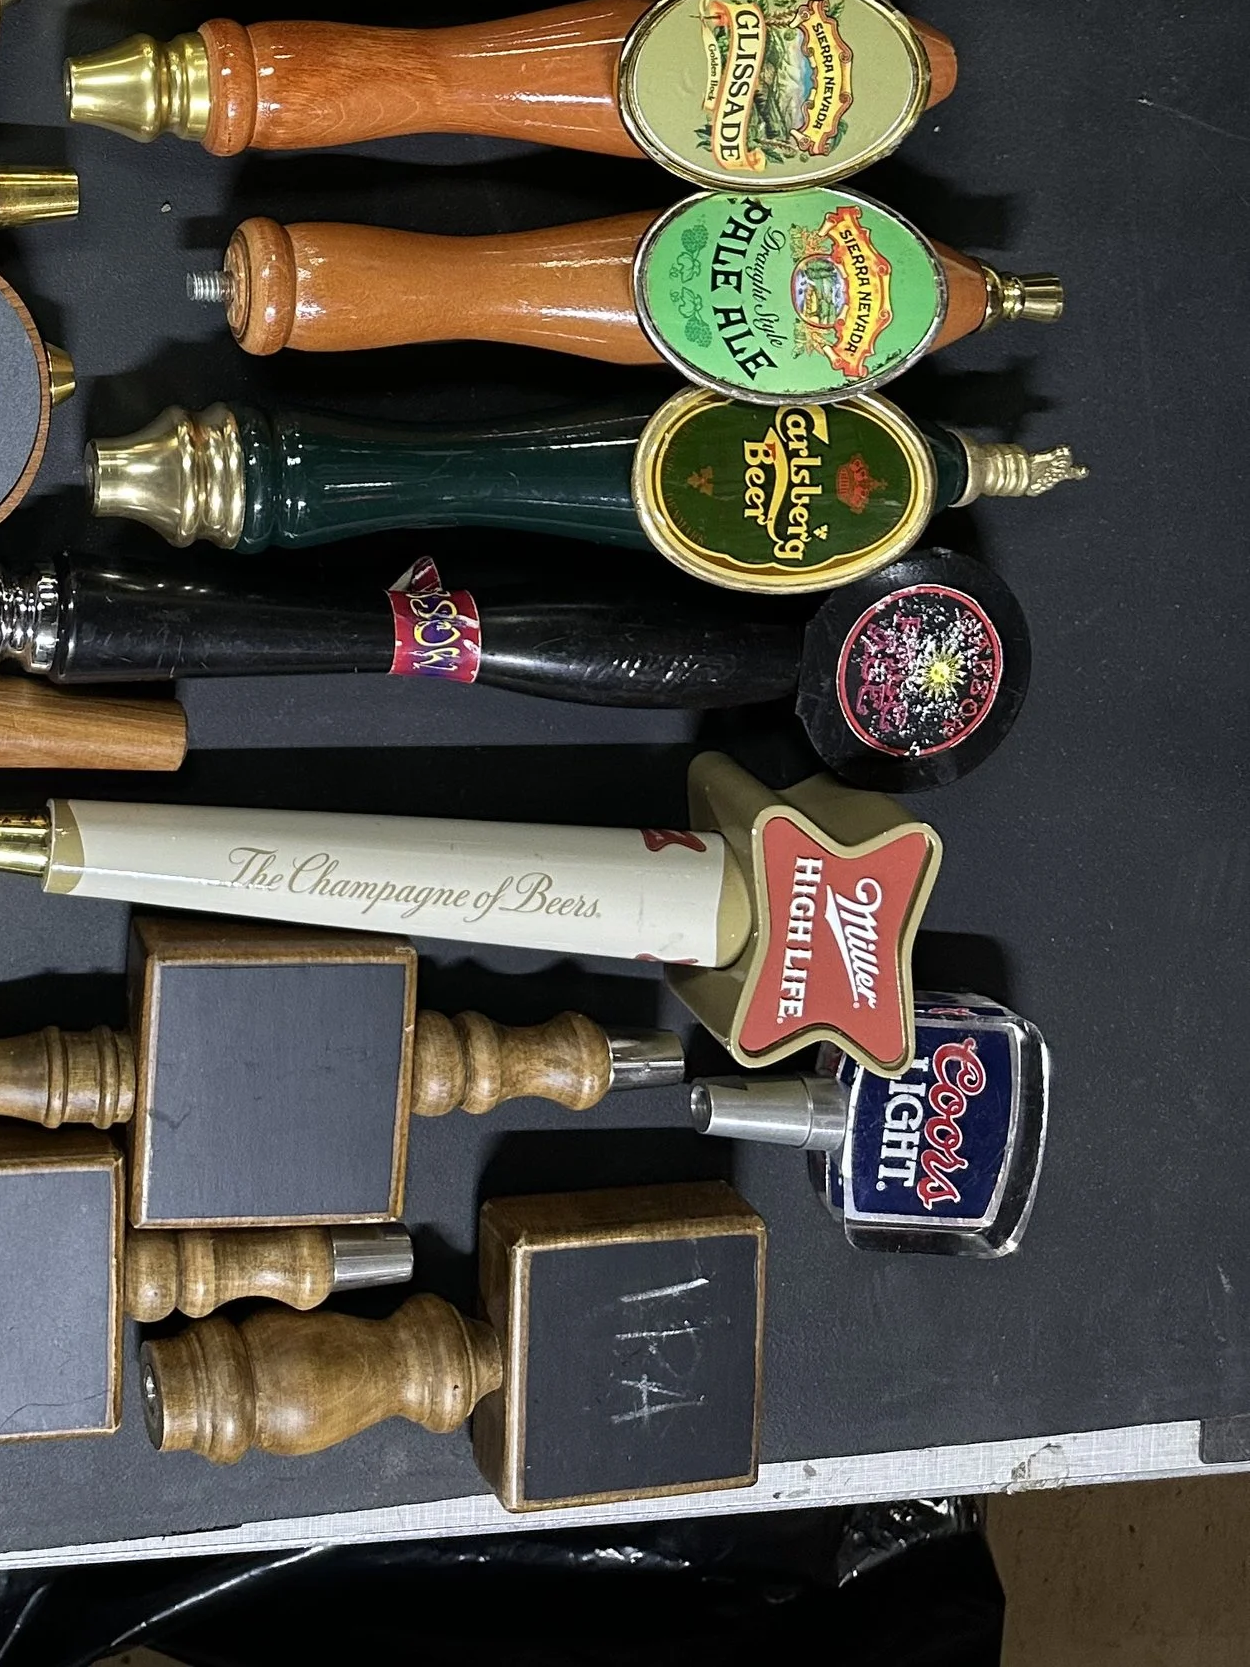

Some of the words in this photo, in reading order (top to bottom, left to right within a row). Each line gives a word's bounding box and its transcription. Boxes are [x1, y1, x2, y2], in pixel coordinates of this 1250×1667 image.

[707, 43, 719, 77] Golden
[811, 22, 834, 69] SIERRA
[720, 9, 760, 163] GLISSADE
[811, 70, 836, 130] NEVADA
[710, 196, 774, 294] PALE
[744, 225, 786, 302] Draught
[838, 229, 870, 286] SIERRA
[713, 305, 779, 381] ALE
[752, 303, 789, 349] Style
[844, 291, 871, 354] NEVADA
[743, 438, 776, 526] Beer
[773, 405, 830, 561] Carlsberg
[227, 846, 286, 892] The
[288, 852, 472, 918] Champagne
[463, 875, 515, 924] of
[500, 871, 598, 919] Beers
[786, 855, 823, 943] HIGH
[777, 946, 813, 1018] LIFE
[834, 877, 883, 1010] Miller
[916, 1037, 987, 1211] Coors
